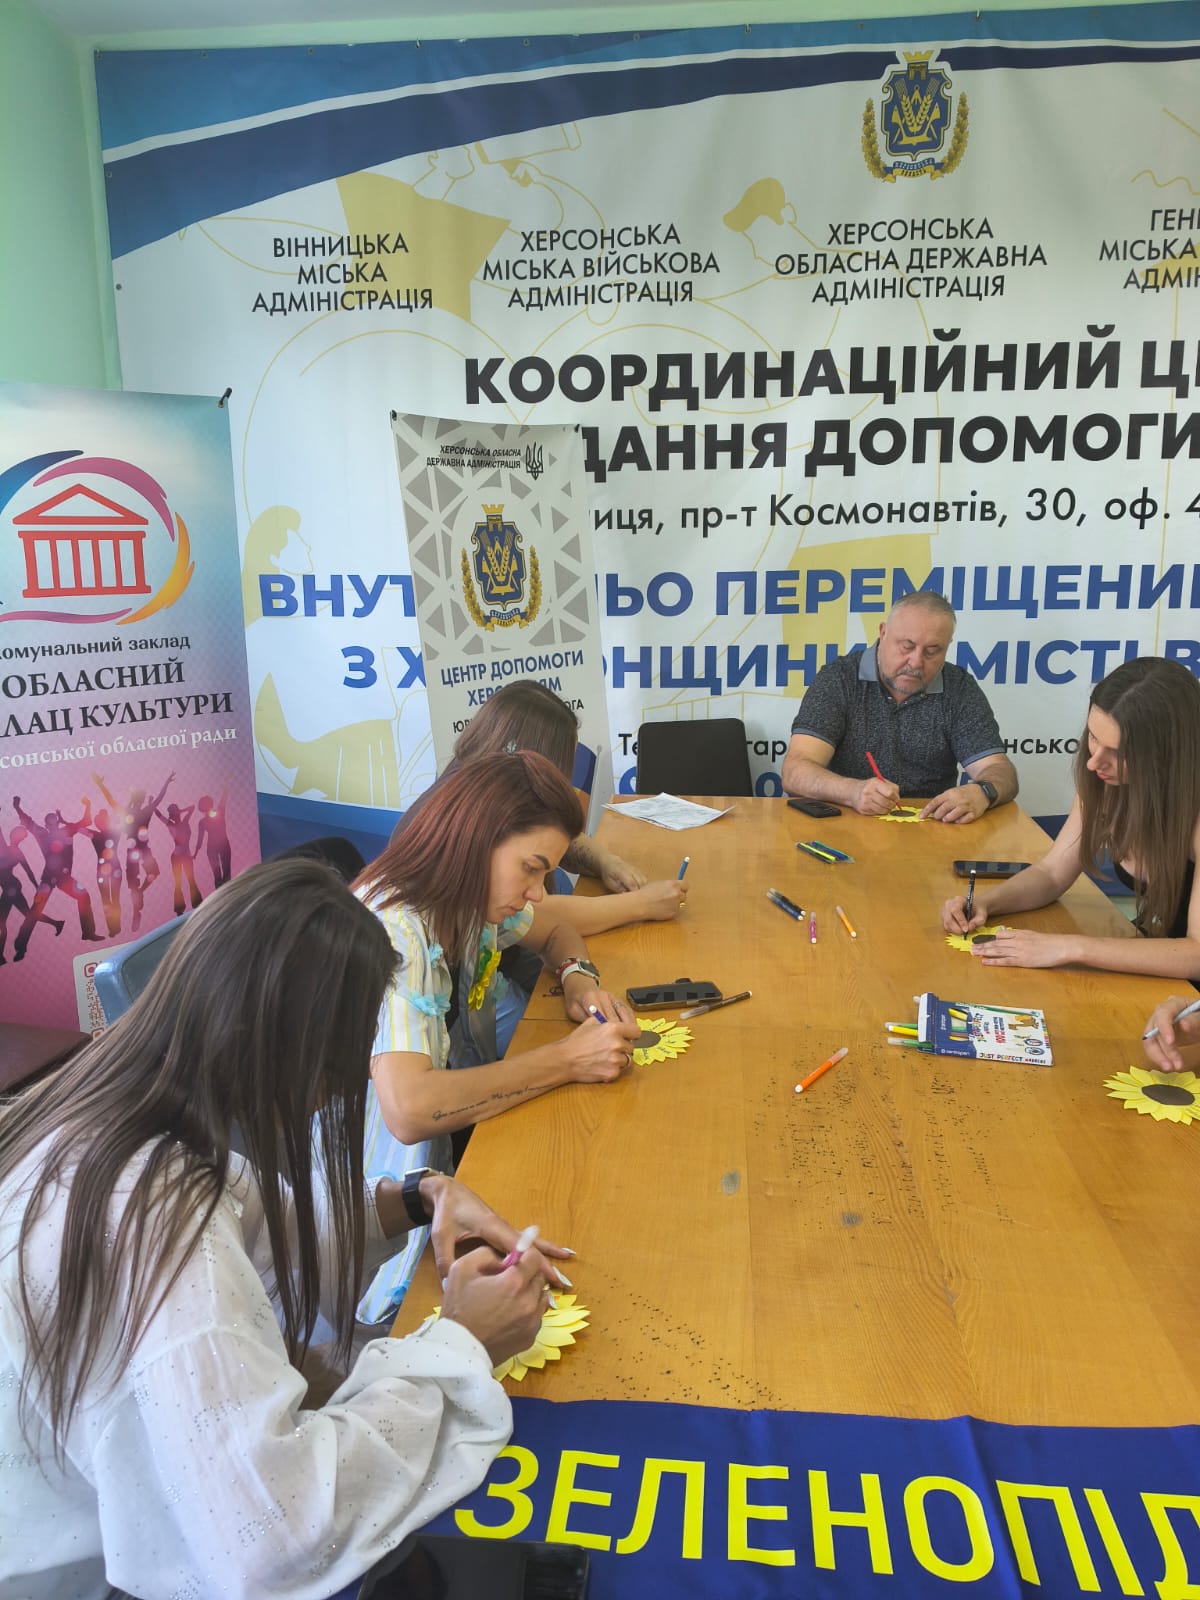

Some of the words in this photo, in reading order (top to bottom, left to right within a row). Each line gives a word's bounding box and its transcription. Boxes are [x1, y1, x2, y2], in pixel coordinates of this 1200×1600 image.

[272, 232, 409, 258] ВІННИЦЬКА
[520, 223, 682, 253] ХЕРСОНСЬКА
[827, 217, 995, 246] ХЕРСОНСЬКА
[774, 250, 900, 276] ОБЛАСНА
[905, 244, 1048, 273] ДЕРЖАВНА
[1098, 237, 1198, 261] МІСЬКА
[297, 262, 388, 285] МІСЬКА
[482, 257, 577, 281] МІСЬКА
[583, 251, 721, 277] ВІЙСЬКОВА
[251, 288, 433, 315] АДМІНІСТРАЦІЯ
[507, 280, 694, 308] АДМІНІСТРАЦІЯ
[811, 275, 1006, 307] АДМІНІСТРАЦІЯ
[465, 324, 1121, 412] КООРДИНАЦІЙНИЙ
[1140, 340, 1200, 399] Ц
[440, 445, 491, 457] ХЕРСОНСЬКА
[492, 449, 521, 457] ОБЛАСНА
[804, 412, 1200, 478] ДОПОМОГИ
[426, 457, 466, 467] ДЕРЖАВНА
[466, 460, 521, 468] АДМІНІСТРАЦІЯ
[681, 505, 757, 538] пр-т
[769, 490, 1006, 528] Космонавтів,
[1025, 488, 1087, 527] 30,
[1104, 487, 1170, 529] оф.
[128, 636, 191, 650] заклад
[1, 657, 186, 700] ОБЛАСНИЙ
[440, 664, 487, 688] ЦЕНТР
[491, 650, 584, 681] ДОПОМОГИ
[79, 692, 233, 729] КУЛЬТУРИ
[99, 731, 187, 757] обласної
[190, 728, 237, 748] ради
